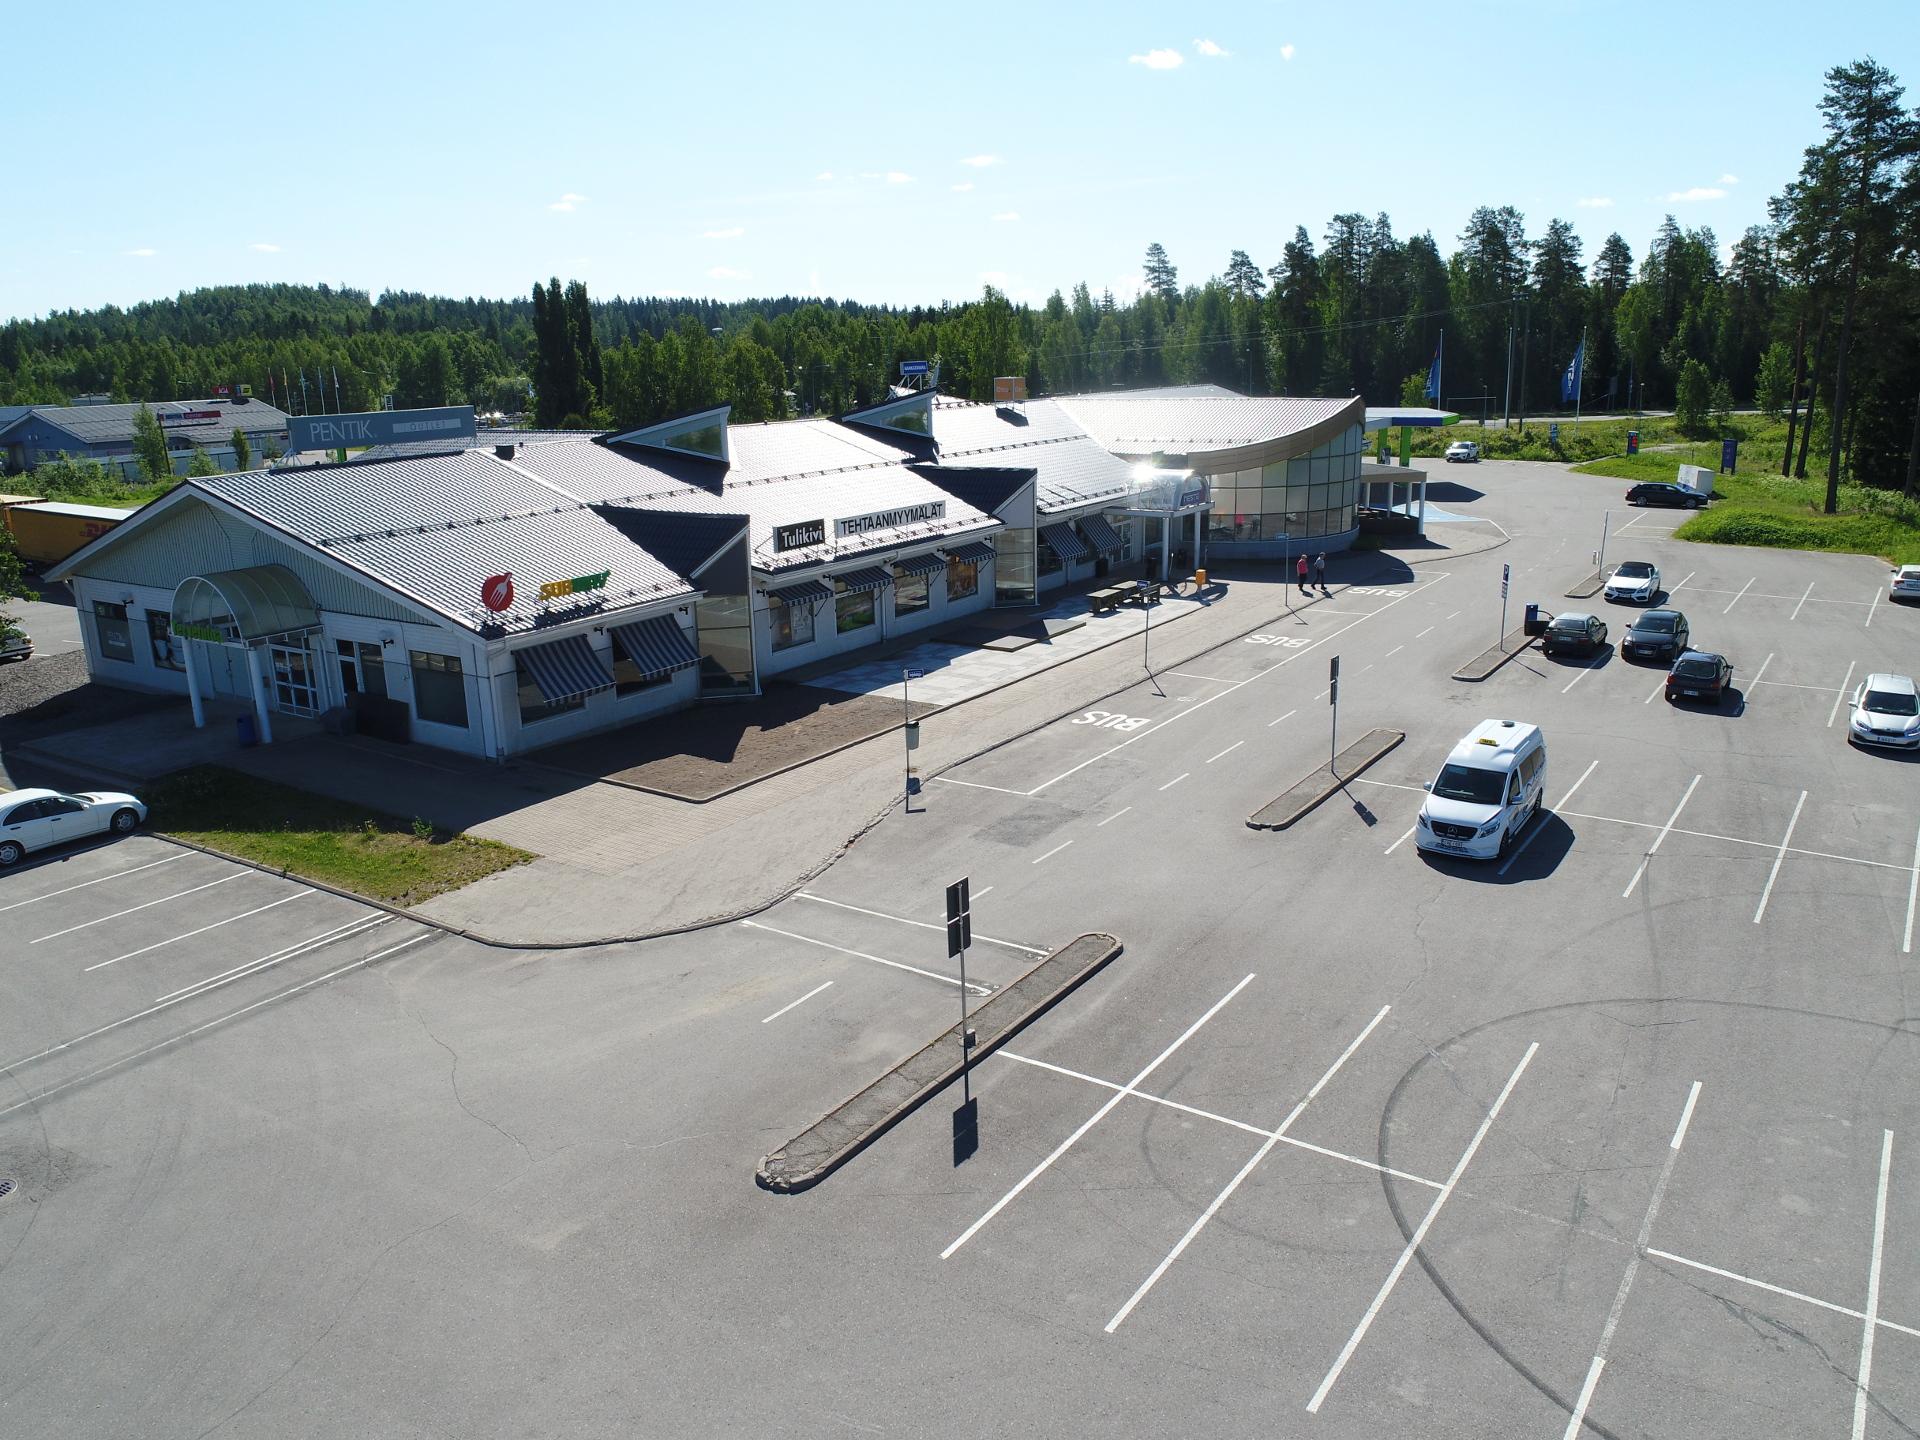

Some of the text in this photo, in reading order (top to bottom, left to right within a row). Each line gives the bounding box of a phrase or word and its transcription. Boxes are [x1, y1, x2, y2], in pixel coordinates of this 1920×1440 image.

[309, 419, 372, 443] PENTIK
[840, 503, 943, 536] TEHTAANMYYMÄLÄT
[781, 525, 824, 548] Tulikivi
[1347, 587, 1410, 598] BUS
[1244, 633, 1313, 649] BUS
[1071, 710, 1152, 732] BUS
